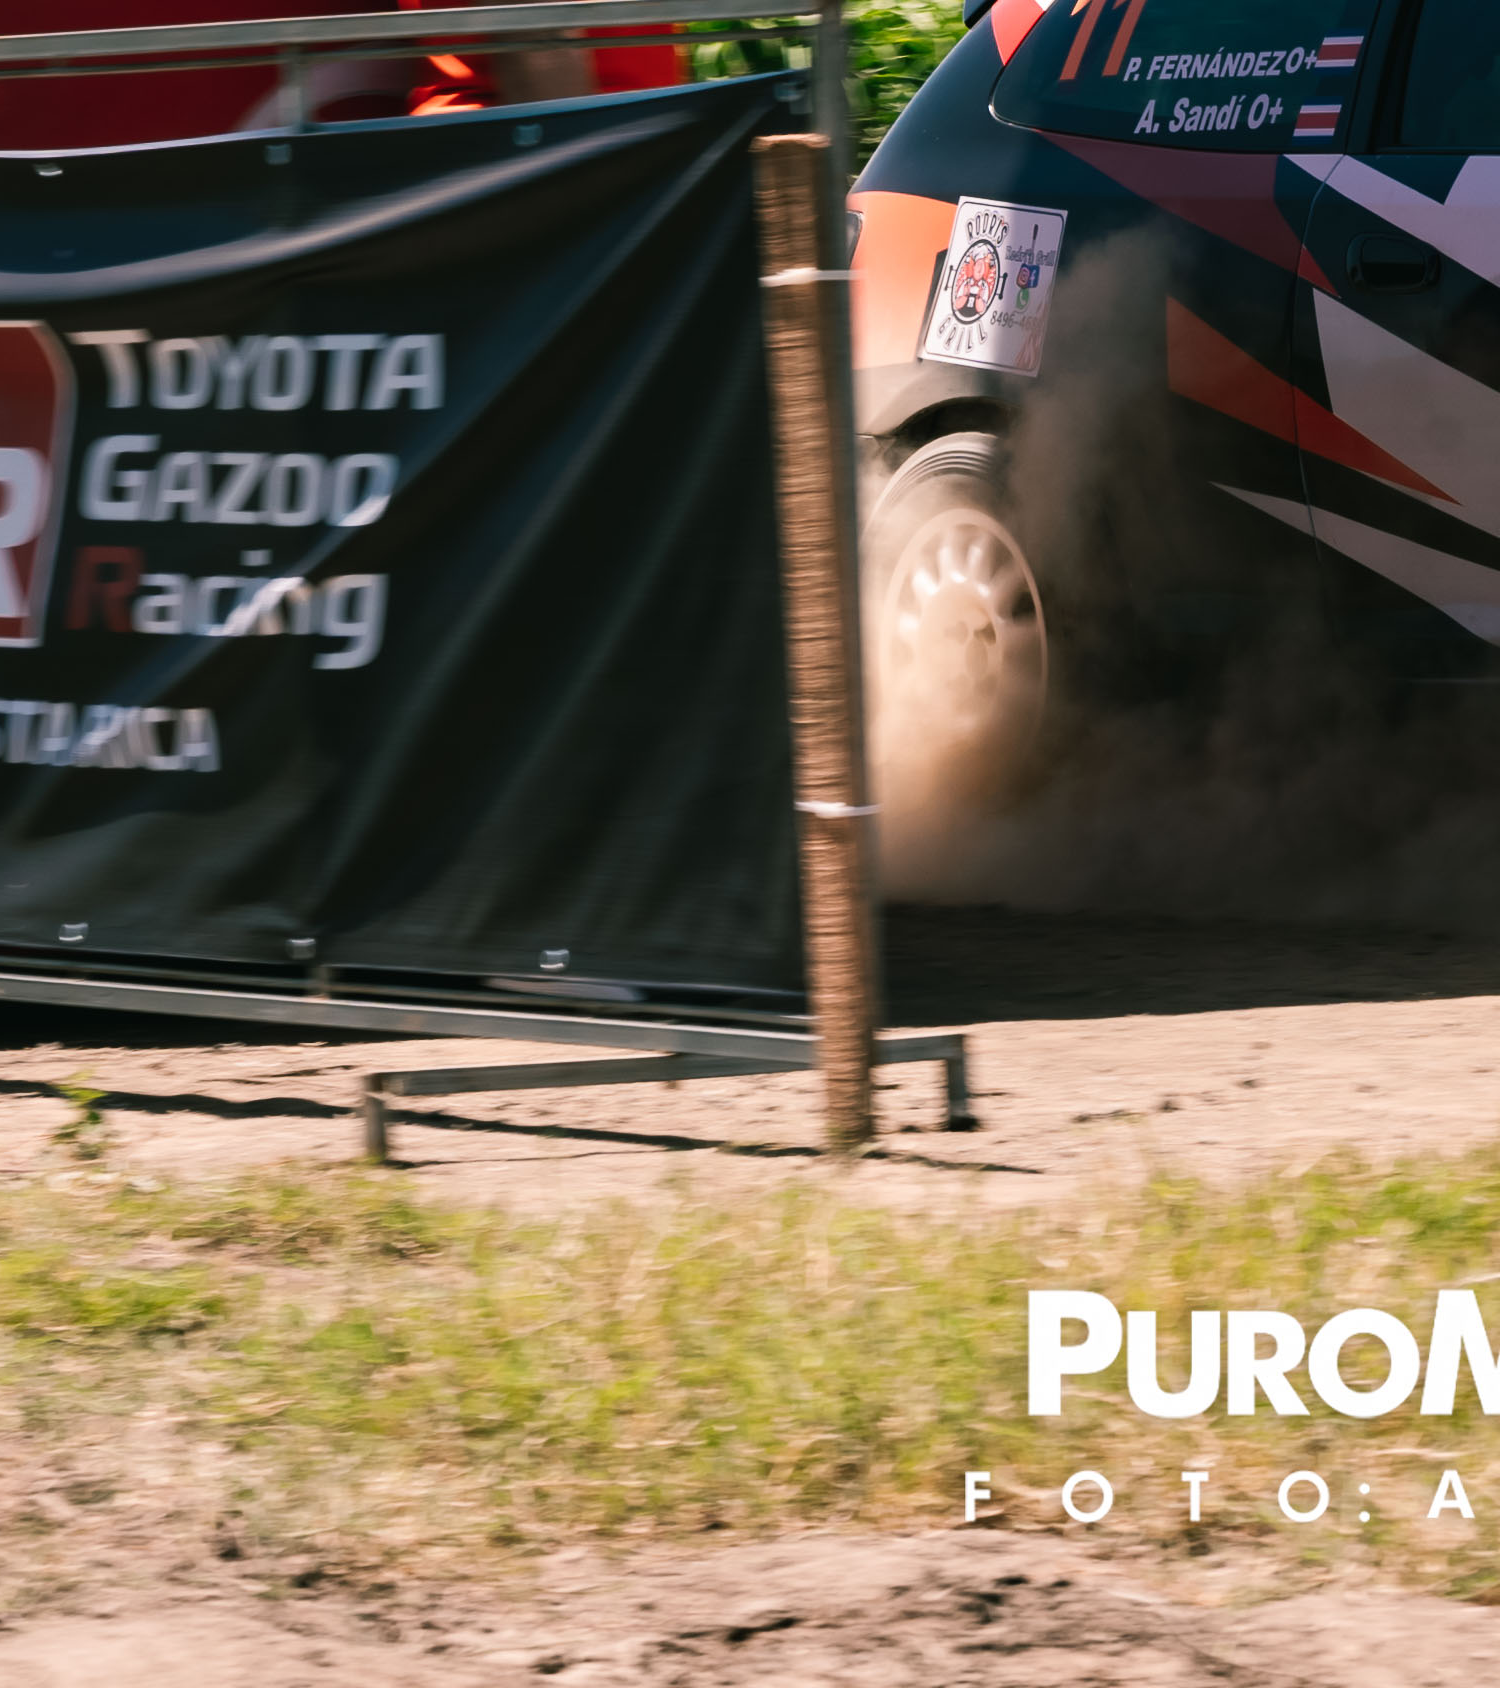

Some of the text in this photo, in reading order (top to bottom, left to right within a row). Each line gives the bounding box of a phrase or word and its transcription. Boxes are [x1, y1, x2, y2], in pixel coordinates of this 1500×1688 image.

[1123, 57, 1140, 81] P.
[1147, 46, 1287, 80] FERNÁNDEZ
[1134, 99, 1159, 134] A.
[1169, 95, 1246, 132] Sandí
[68, 329, 445, 412] TOYOTA
[83, 433, 399, 528] GAZOO
[68, 546, 388, 671] Racing
